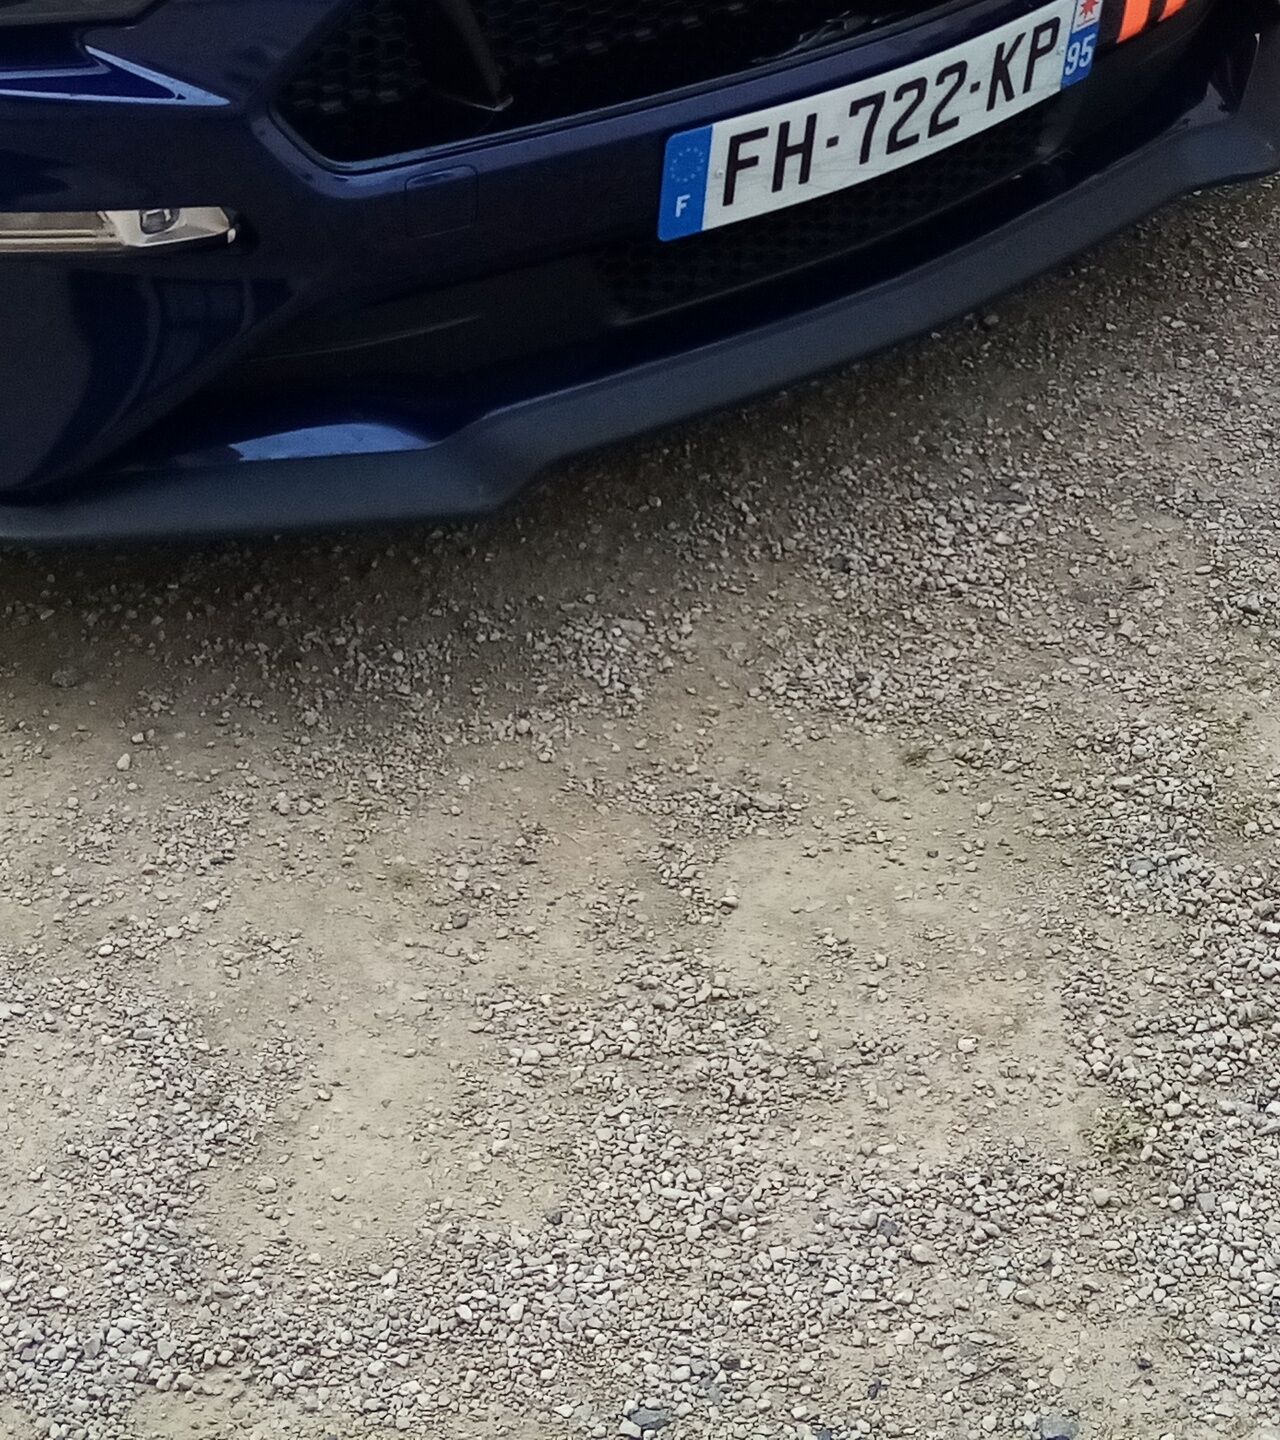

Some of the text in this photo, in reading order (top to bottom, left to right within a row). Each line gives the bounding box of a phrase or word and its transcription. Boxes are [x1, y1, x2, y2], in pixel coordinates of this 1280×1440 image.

[1064, 33, 1097, 76] 95
[722, 16, 1061, 207] FH-722-KP
[674, 194, 689, 218] F
